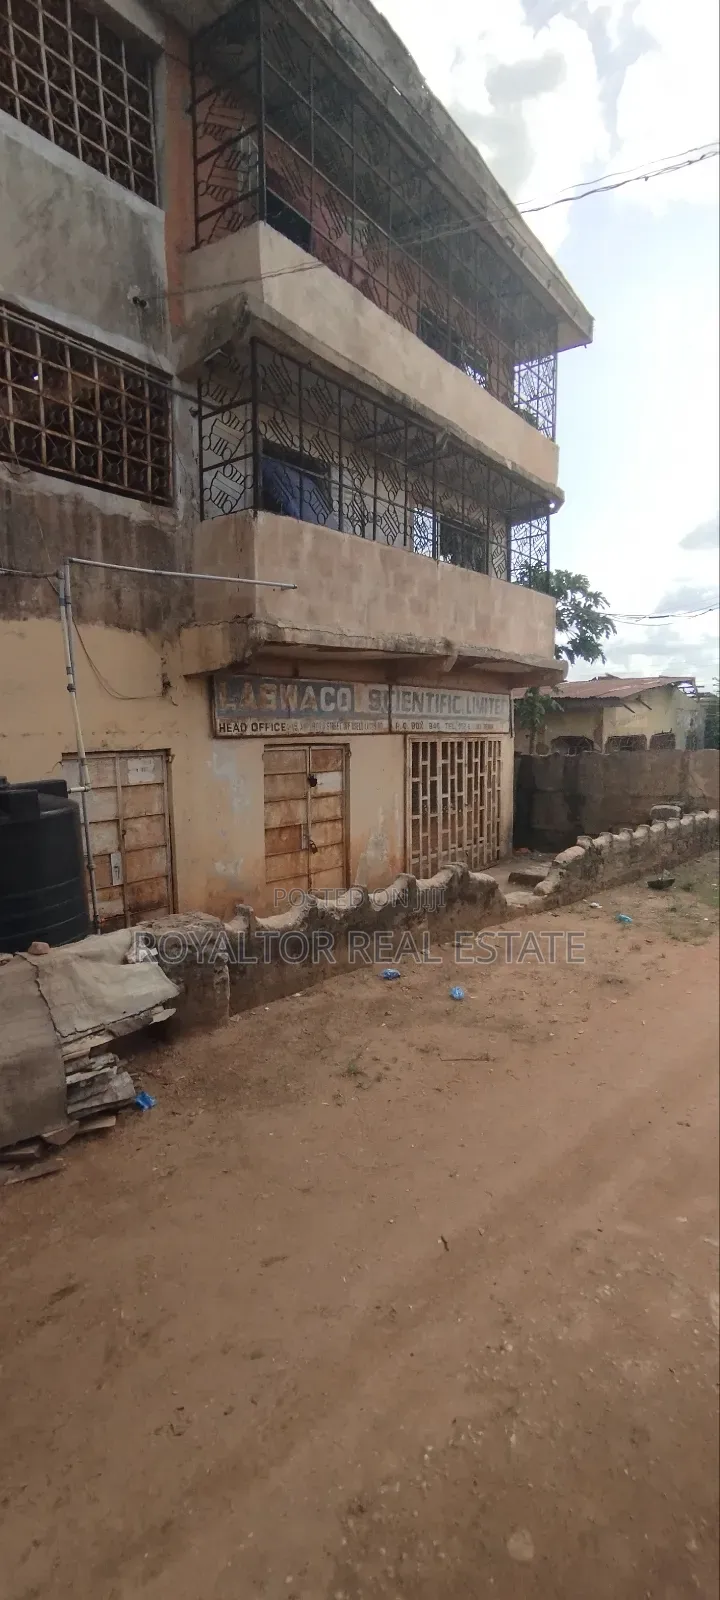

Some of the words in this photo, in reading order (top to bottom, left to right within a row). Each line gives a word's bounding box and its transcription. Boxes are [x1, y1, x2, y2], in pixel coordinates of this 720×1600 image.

[219, 722, 248, 733] HEAD
[251, 721, 286, 732] OFFICE
[411, 721, 424, 731] BOX
